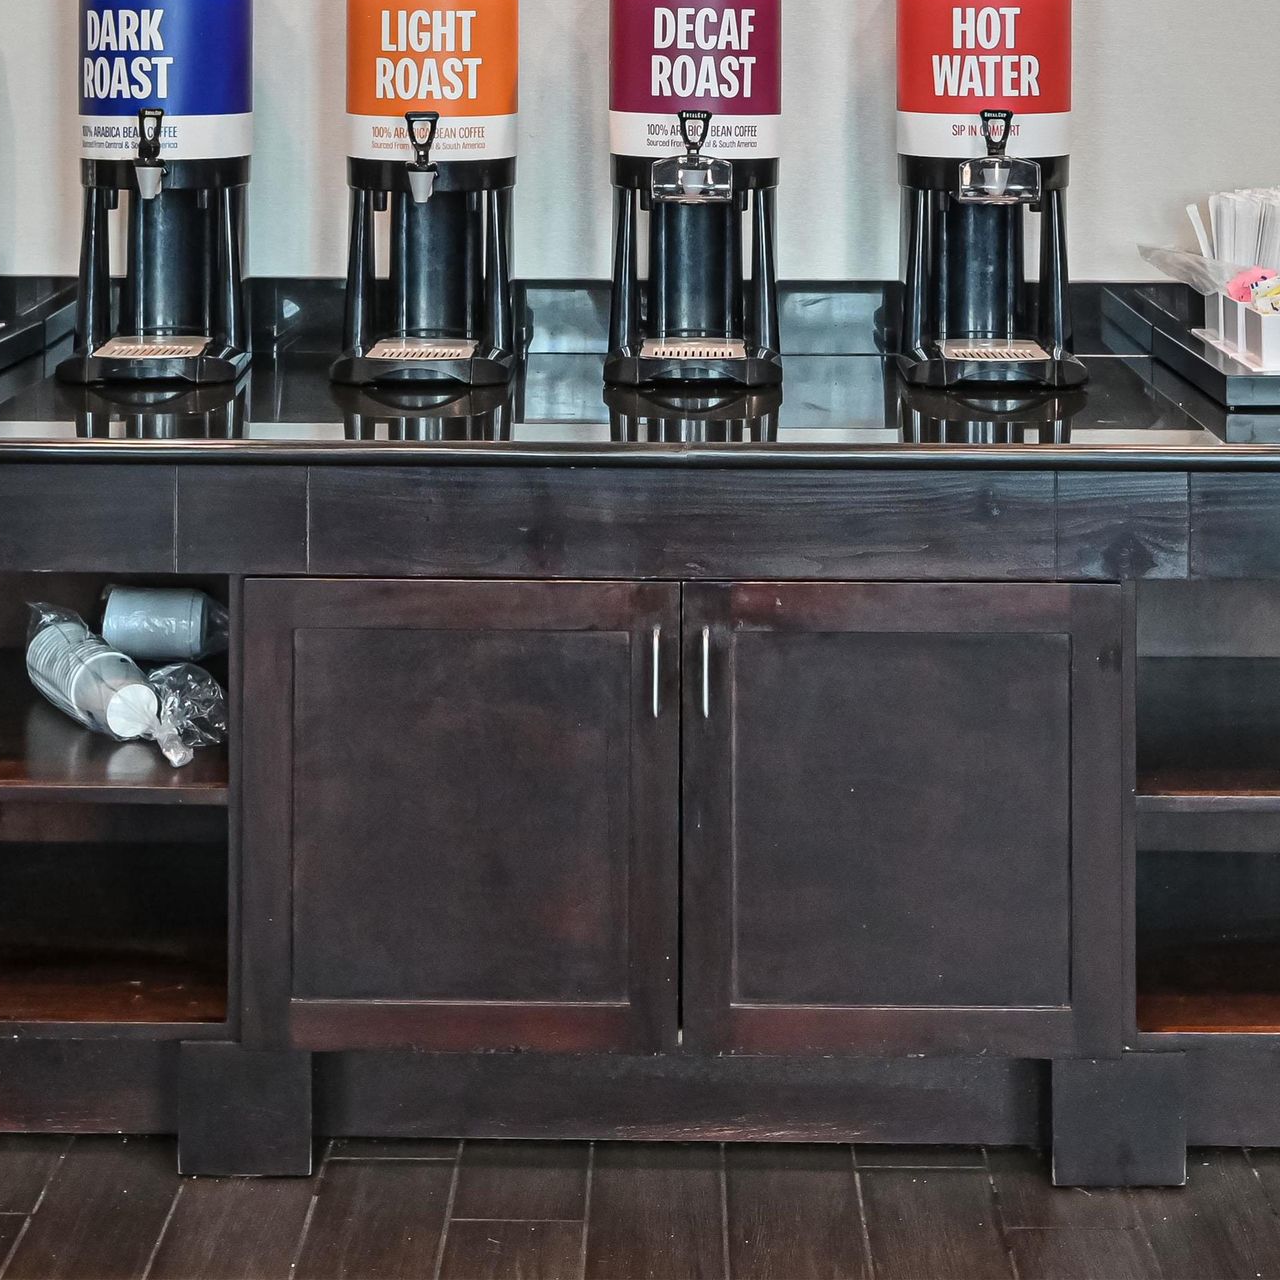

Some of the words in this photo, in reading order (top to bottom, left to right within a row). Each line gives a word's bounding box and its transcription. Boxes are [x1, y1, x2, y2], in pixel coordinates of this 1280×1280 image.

[86, 9, 164, 51] DARK
[381, 9, 477, 52] LIGHT
[653, 7, 756, 50] DECAF
[952, 7, 1021, 49] HOT
[83, 56, 174, 99] ROAST
[375, 57, 483, 100] ROAST
[651, 55, 757, 98] ROAST
[931, 55, 1040, 97] WATER
[94, 126, 121, 138] ARABICA
[123, 126, 140, 138] BEA
[147, 125, 178, 138] CFFEE
[124, 141, 130, 149] &
[372, 126, 392, 138] 100%
[394, 127, 430, 139] ARAICA
[435, 127, 457, 139] BEAN
[458, 126, 485, 139] COFFEE
[372, 141, 393, 149] Sourced
[394, 142, 410, 150] From
[435, 142, 441, 150] &
[442, 142, 461, 150] South
[462, 141, 485, 149] America
[646, 138, 670, 147] Sourced
[713, 140, 718, 148] &
[719, 140, 736, 148] South
[737, 140, 757, 148] America
[647, 124, 669, 136] 100%
[670, 125, 702, 137] ARBIC
[711, 125, 732, 137] BEAN
[734, 125, 757, 137] COFFEE
[951, 124, 966, 136] SIP
[968, 124, 977, 136] IN
[980, 124, 1020, 137] CMFRT
